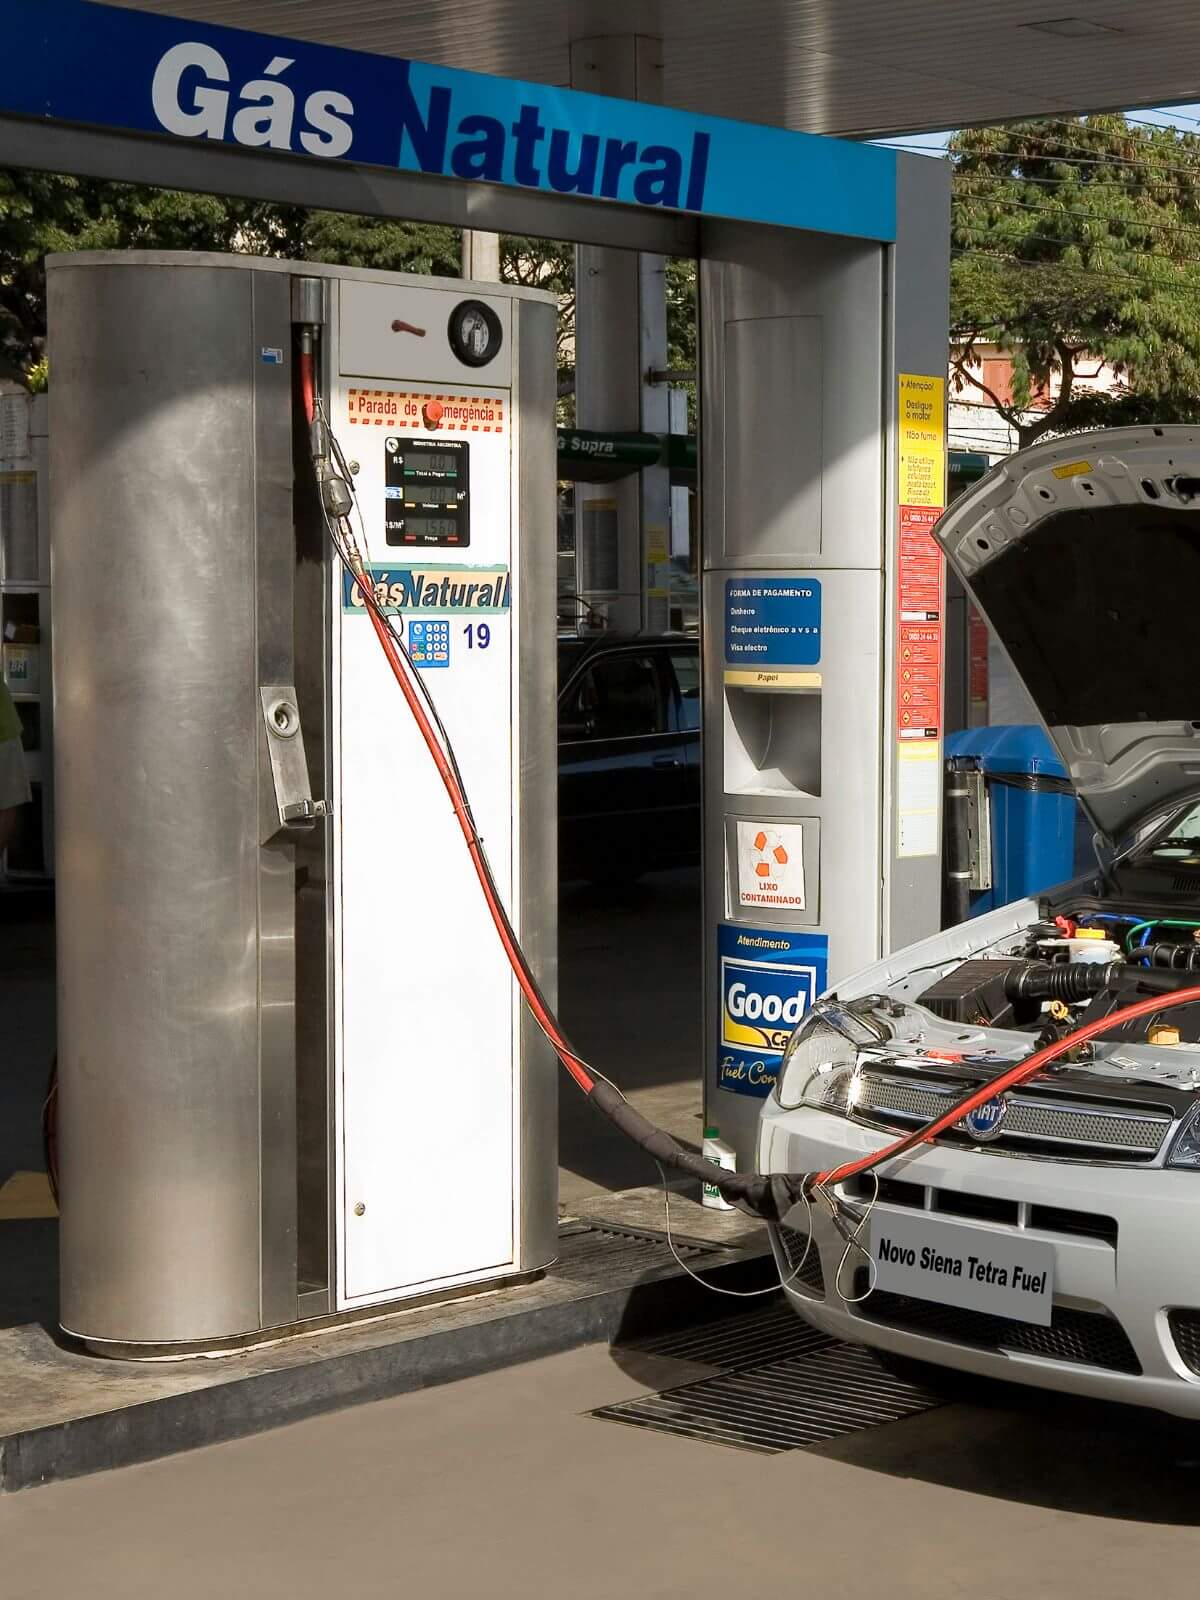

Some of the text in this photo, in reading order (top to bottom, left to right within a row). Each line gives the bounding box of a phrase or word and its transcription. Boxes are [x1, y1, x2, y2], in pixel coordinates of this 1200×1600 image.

[152, 41, 711, 212] Gás Natural
[358, 397, 495, 424] Parada de mergência
[571, 437, 614, 455] Supra
[406, 574, 504, 608] Natural
[729, 588, 812, 598] FORMA DE PAGAMENTO
[463, 622, 491, 649] 19
[730, 625, 752, 635] Cheque
[730, 643, 743, 652] Visa
[757, 673, 779, 683] Papel
[759, 882, 779, 892] LIXO
[741, 892, 802, 905] CONTAMINADO
[737, 935, 791, 950] Atendimento
[728, 983, 807, 1025] Good
[720, 1056, 746, 1081] Fuel
[878, 1237, 1048, 1295] Novo Siena Tetra Fuel
